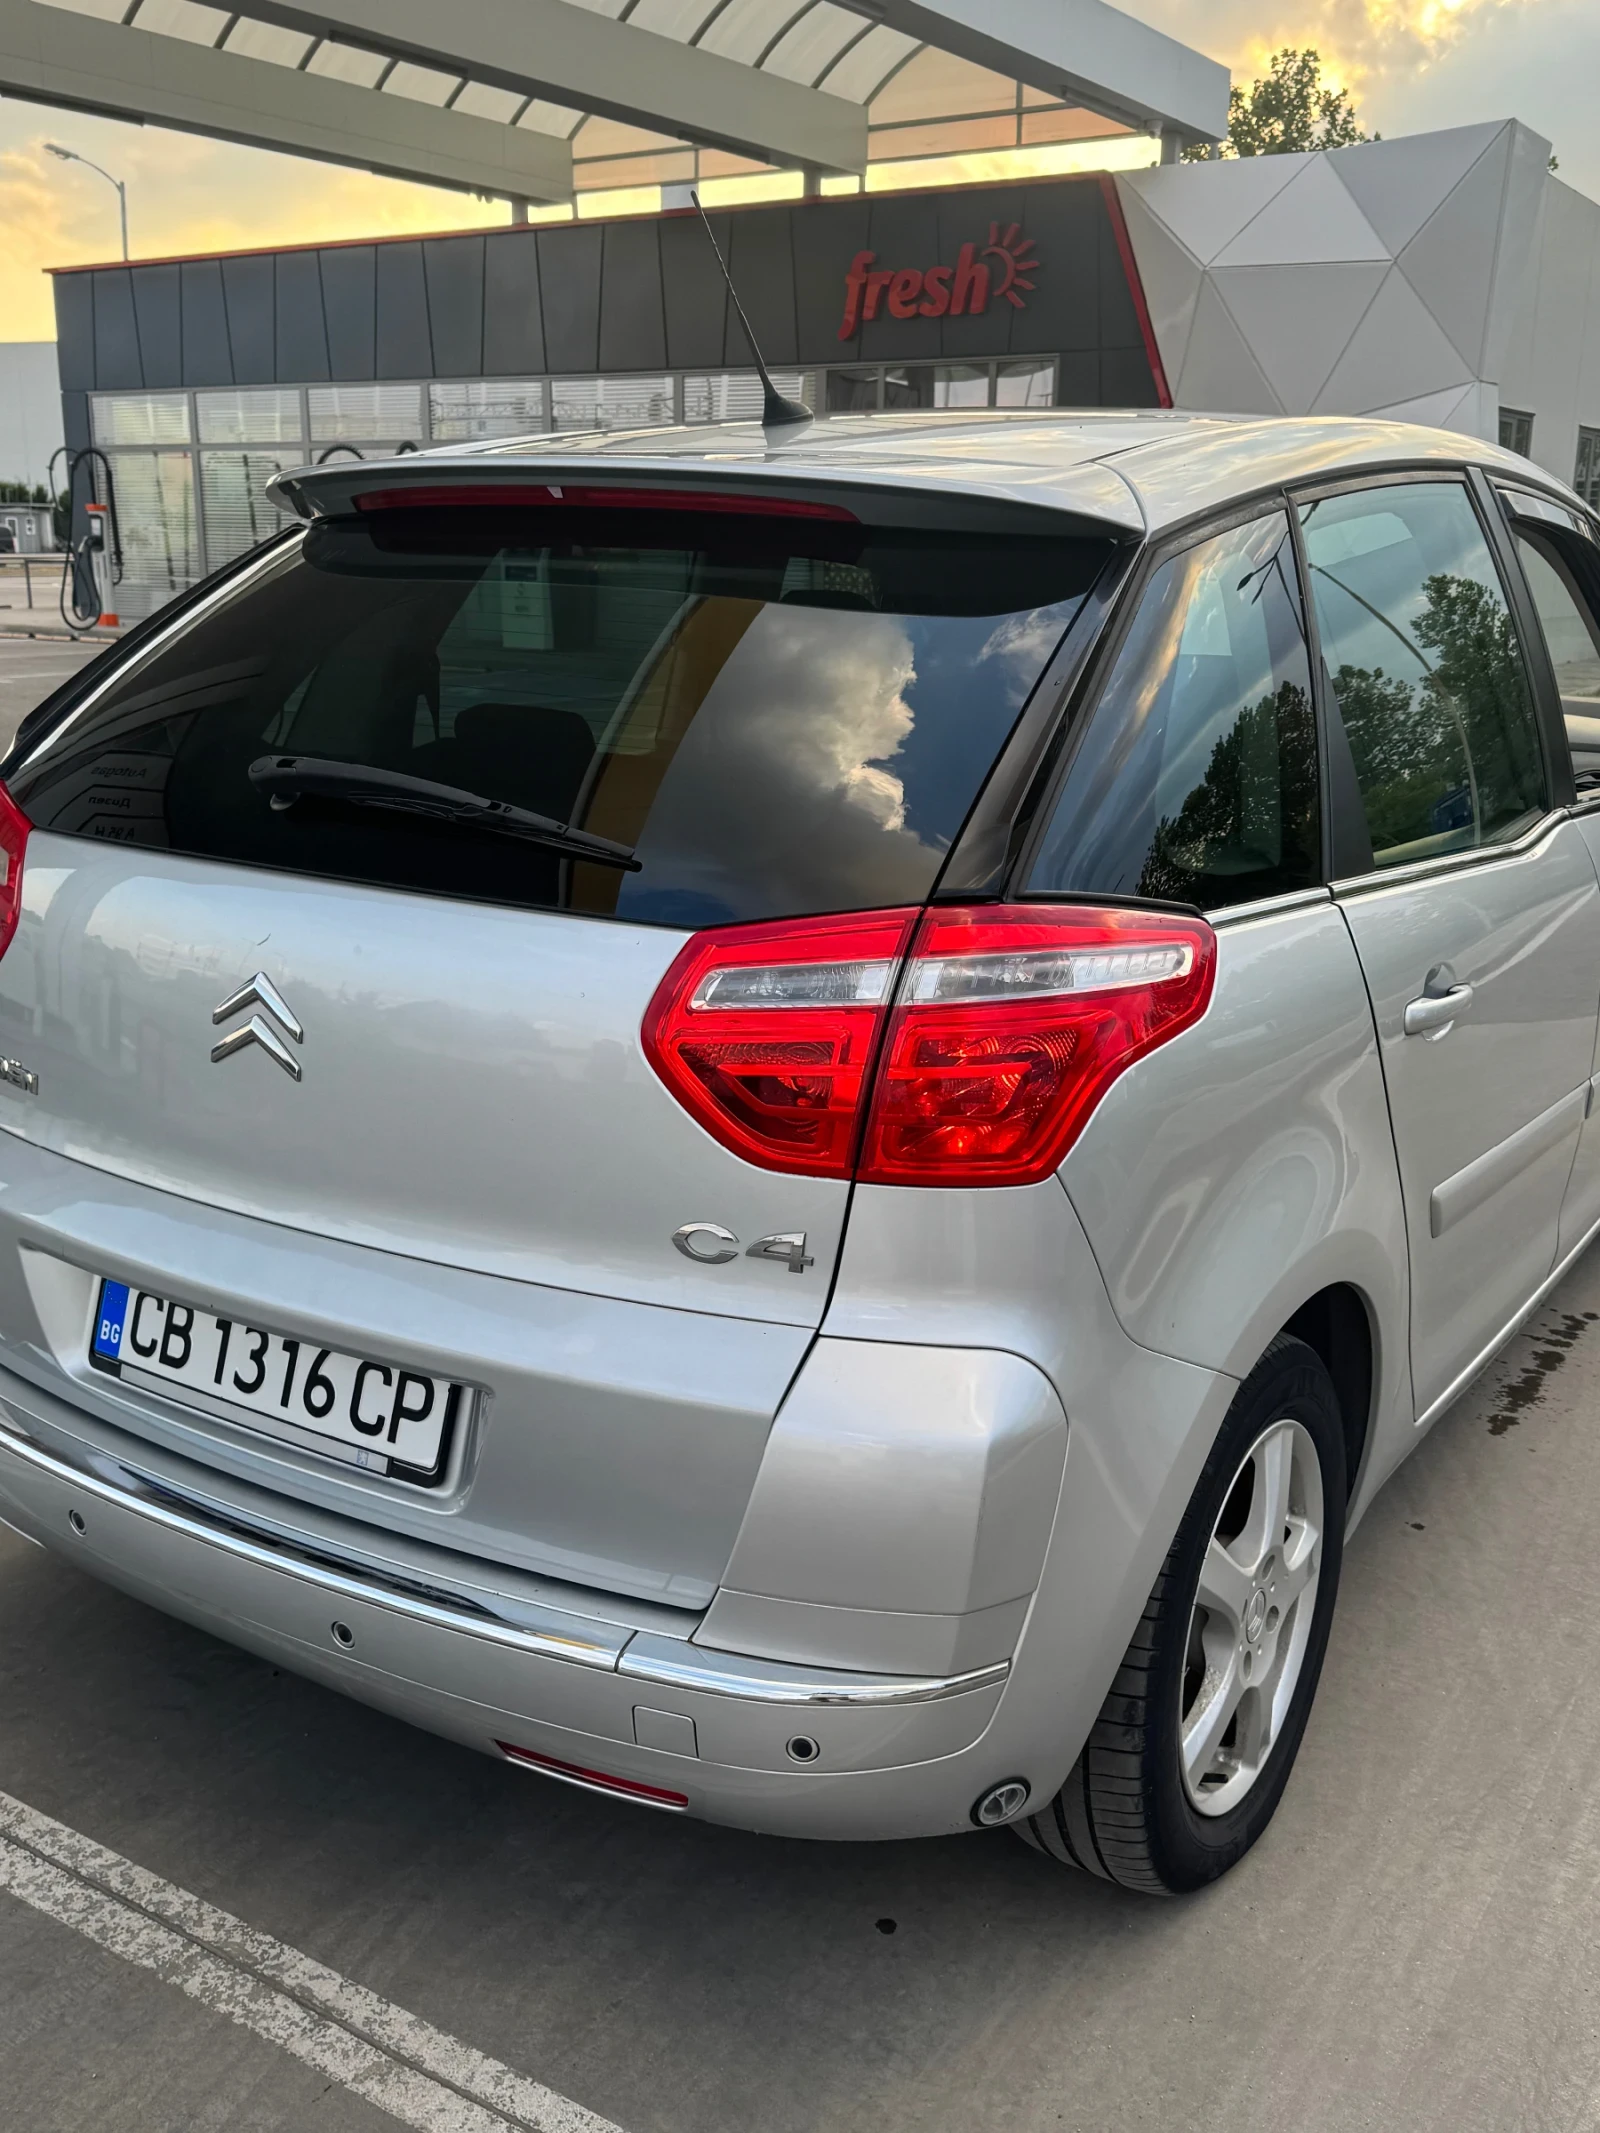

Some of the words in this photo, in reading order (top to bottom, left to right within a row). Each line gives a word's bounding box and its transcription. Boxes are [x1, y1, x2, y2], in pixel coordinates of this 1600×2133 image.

[838, 242, 989, 341] fresh
[100, 1319, 120, 1344] BG
[130, 1291, 195, 1369] CB
[214, 1318, 336, 1418] 1316
[349, 1360, 435, 1443] CP
